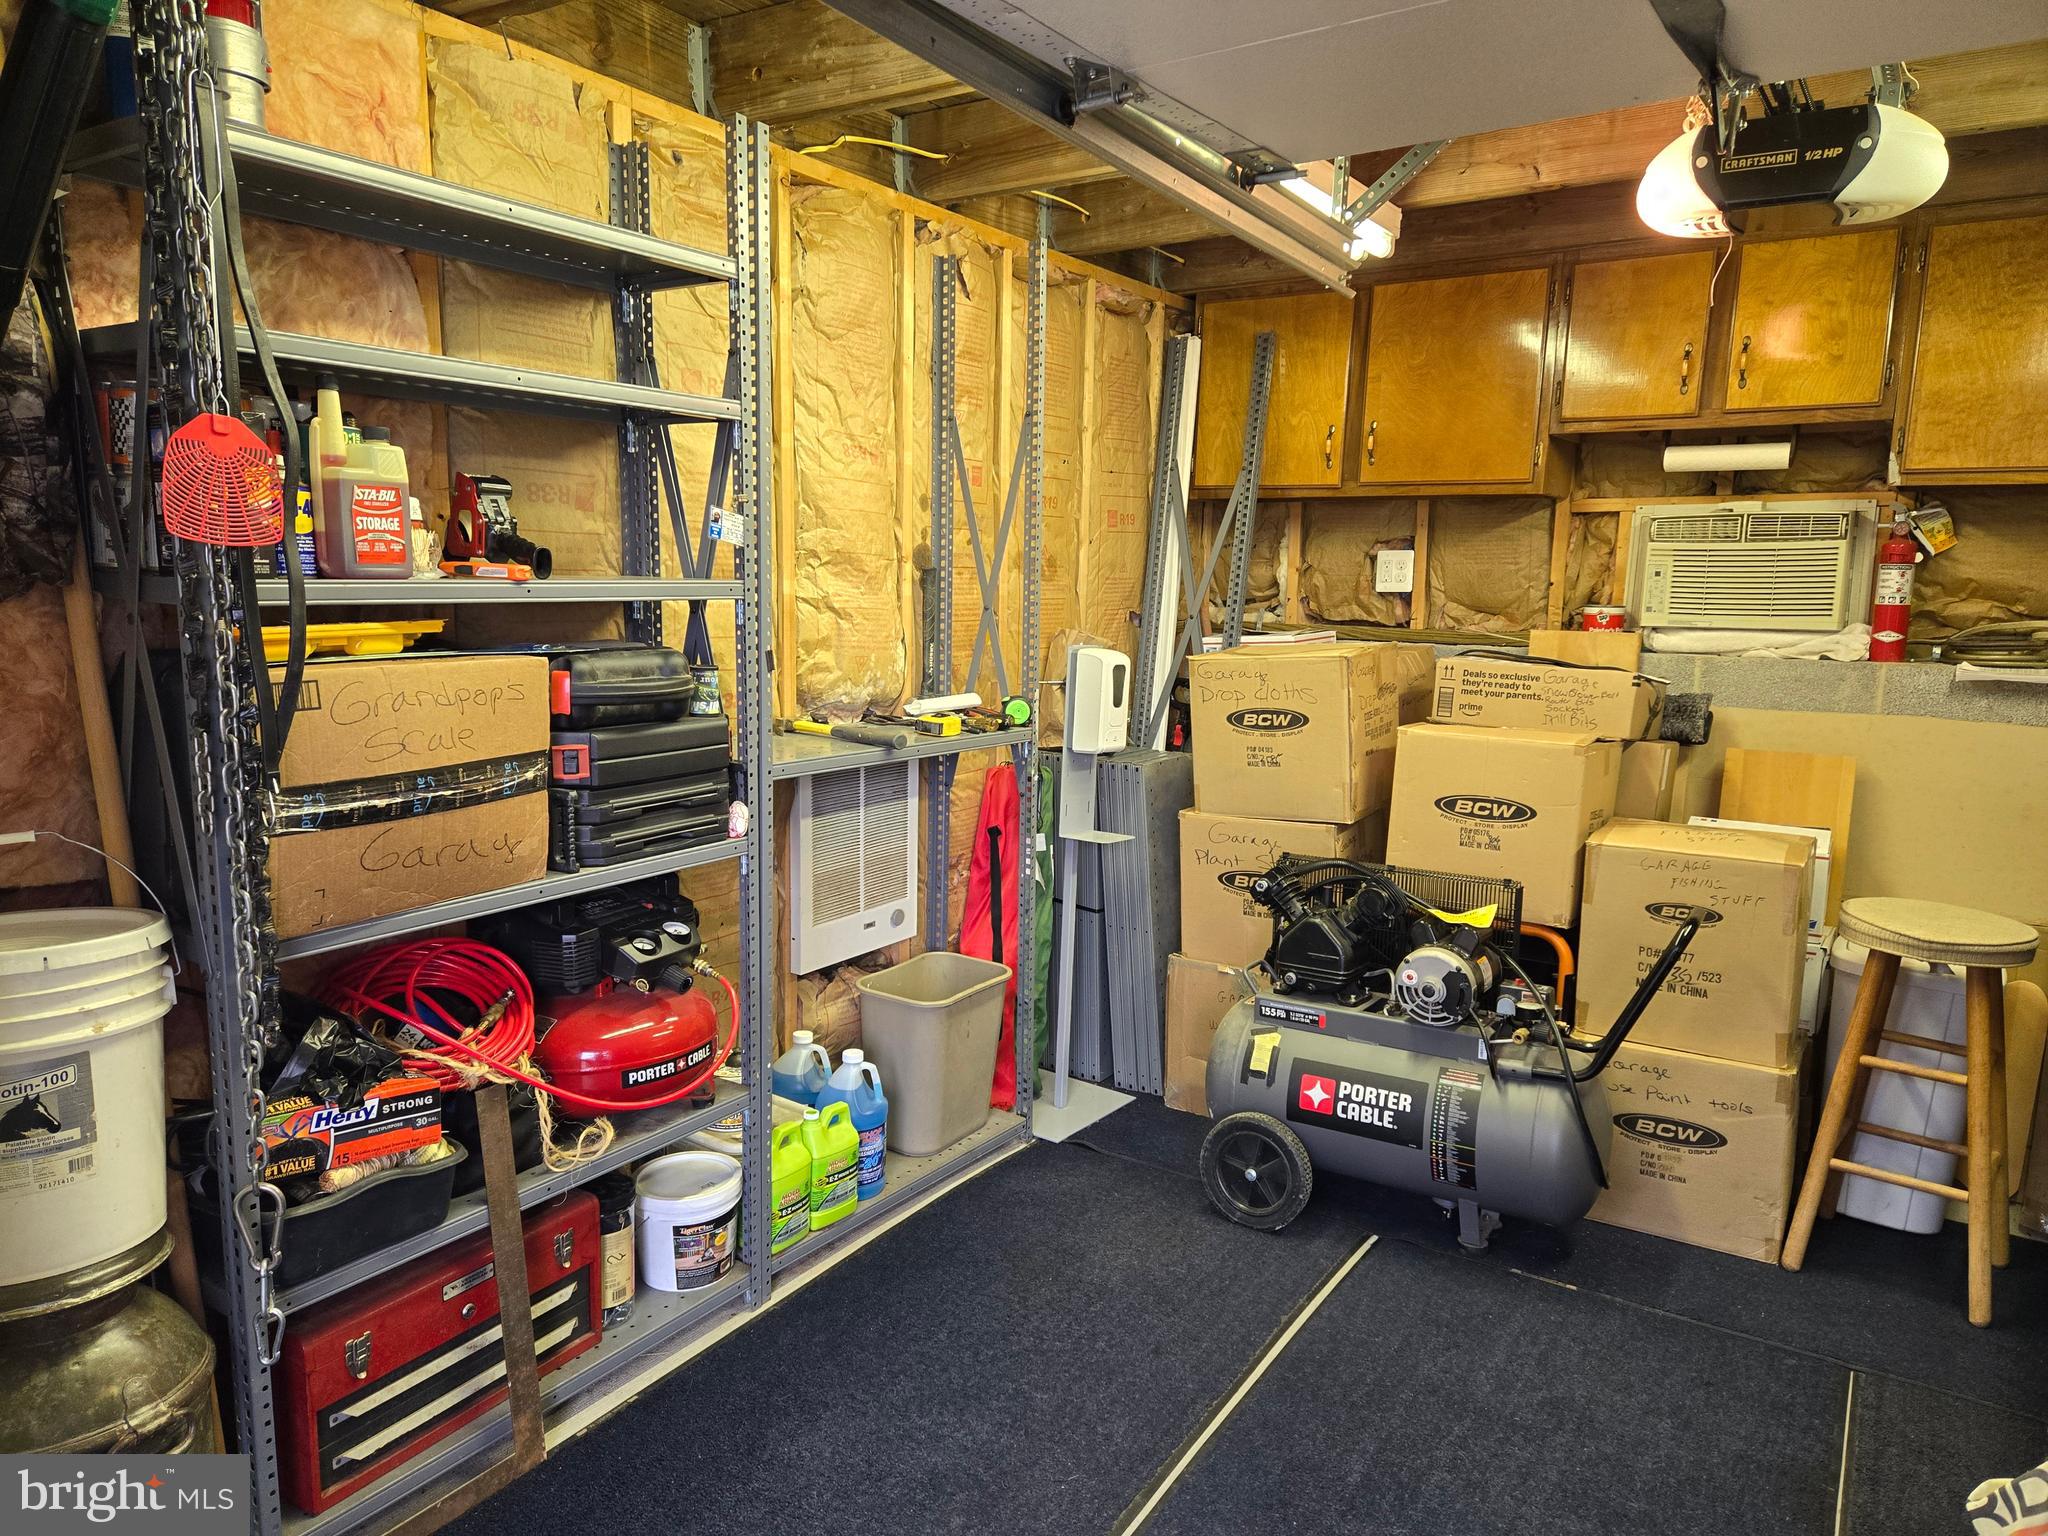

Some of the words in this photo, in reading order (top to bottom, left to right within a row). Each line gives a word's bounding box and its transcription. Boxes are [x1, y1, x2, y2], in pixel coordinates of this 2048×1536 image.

[1724, 153, 1794, 169] CRAFTSMAN
[1804, 150, 1822, 161] 1/2
[1823, 147, 1844, 159] HP
[355, 488, 397, 501] STA-BIL
[355, 516, 401, 531] STORAGE
[1197, 662, 1269, 687] Garage
[1463, 669, 1487, 679] Deals
[1500, 672, 1541, 683] exclusive
[1543, 669, 1599, 691] Garage
[1462, 679, 1493, 689] they're
[1494, 682, 1520, 692] ready
[1522, 683, 1532, 691] to
[1200, 685, 1246, 708] Drop
[1460, 688, 1483, 696] meet
[1484, 690, 1506, 699] your
[1506, 691, 1545, 702] parents.
[1458, 703, 1483, 712] prime
[1242, 713, 1293, 727] BCW
[1570, 713, 1598, 730] Bits
[1454, 799, 1518, 818] BCW
[1440, 813, 1467, 825] PROTECT
[1459, 840, 1475, 848] MADE
[1194, 849, 1247, 868] Plant
[1640, 857, 1713, 873] GARAGE
[1222, 887, 1246, 897] PROTECT
[1708, 895, 1767, 907] STUFF
[1667, 983, 1676, 994] IN
[1680, 984, 1709, 999] CHINA
[1261, 1006, 1276, 1016] 155
[628, 1062, 675, 1084] PORTER
[688, 1044, 711, 1066] CABLE
[277, 1095, 312, 1110] VALUE
[382, 1095, 433, 1114] STRONG
[1338, 1081, 1413, 1113] PORTER
[1646, 1085, 1692, 1104] Paint
[1709, 1099, 1753, 1115] tools
[415, 1117, 428, 1127] 30
[1336, 1100, 1396, 1130] CABLE
[1635, 1119, 1705, 1143] BCW
[1619, 1131, 1651, 1146] PROTECT
[1658, 1144, 1681, 1153] STORE
[281, 1156, 316, 1174] VALUE
[335, 1152, 350, 1166] 15
[1640, 1168, 1658, 1178] MADE
[1668, 1174, 1687, 1184] CHINA
